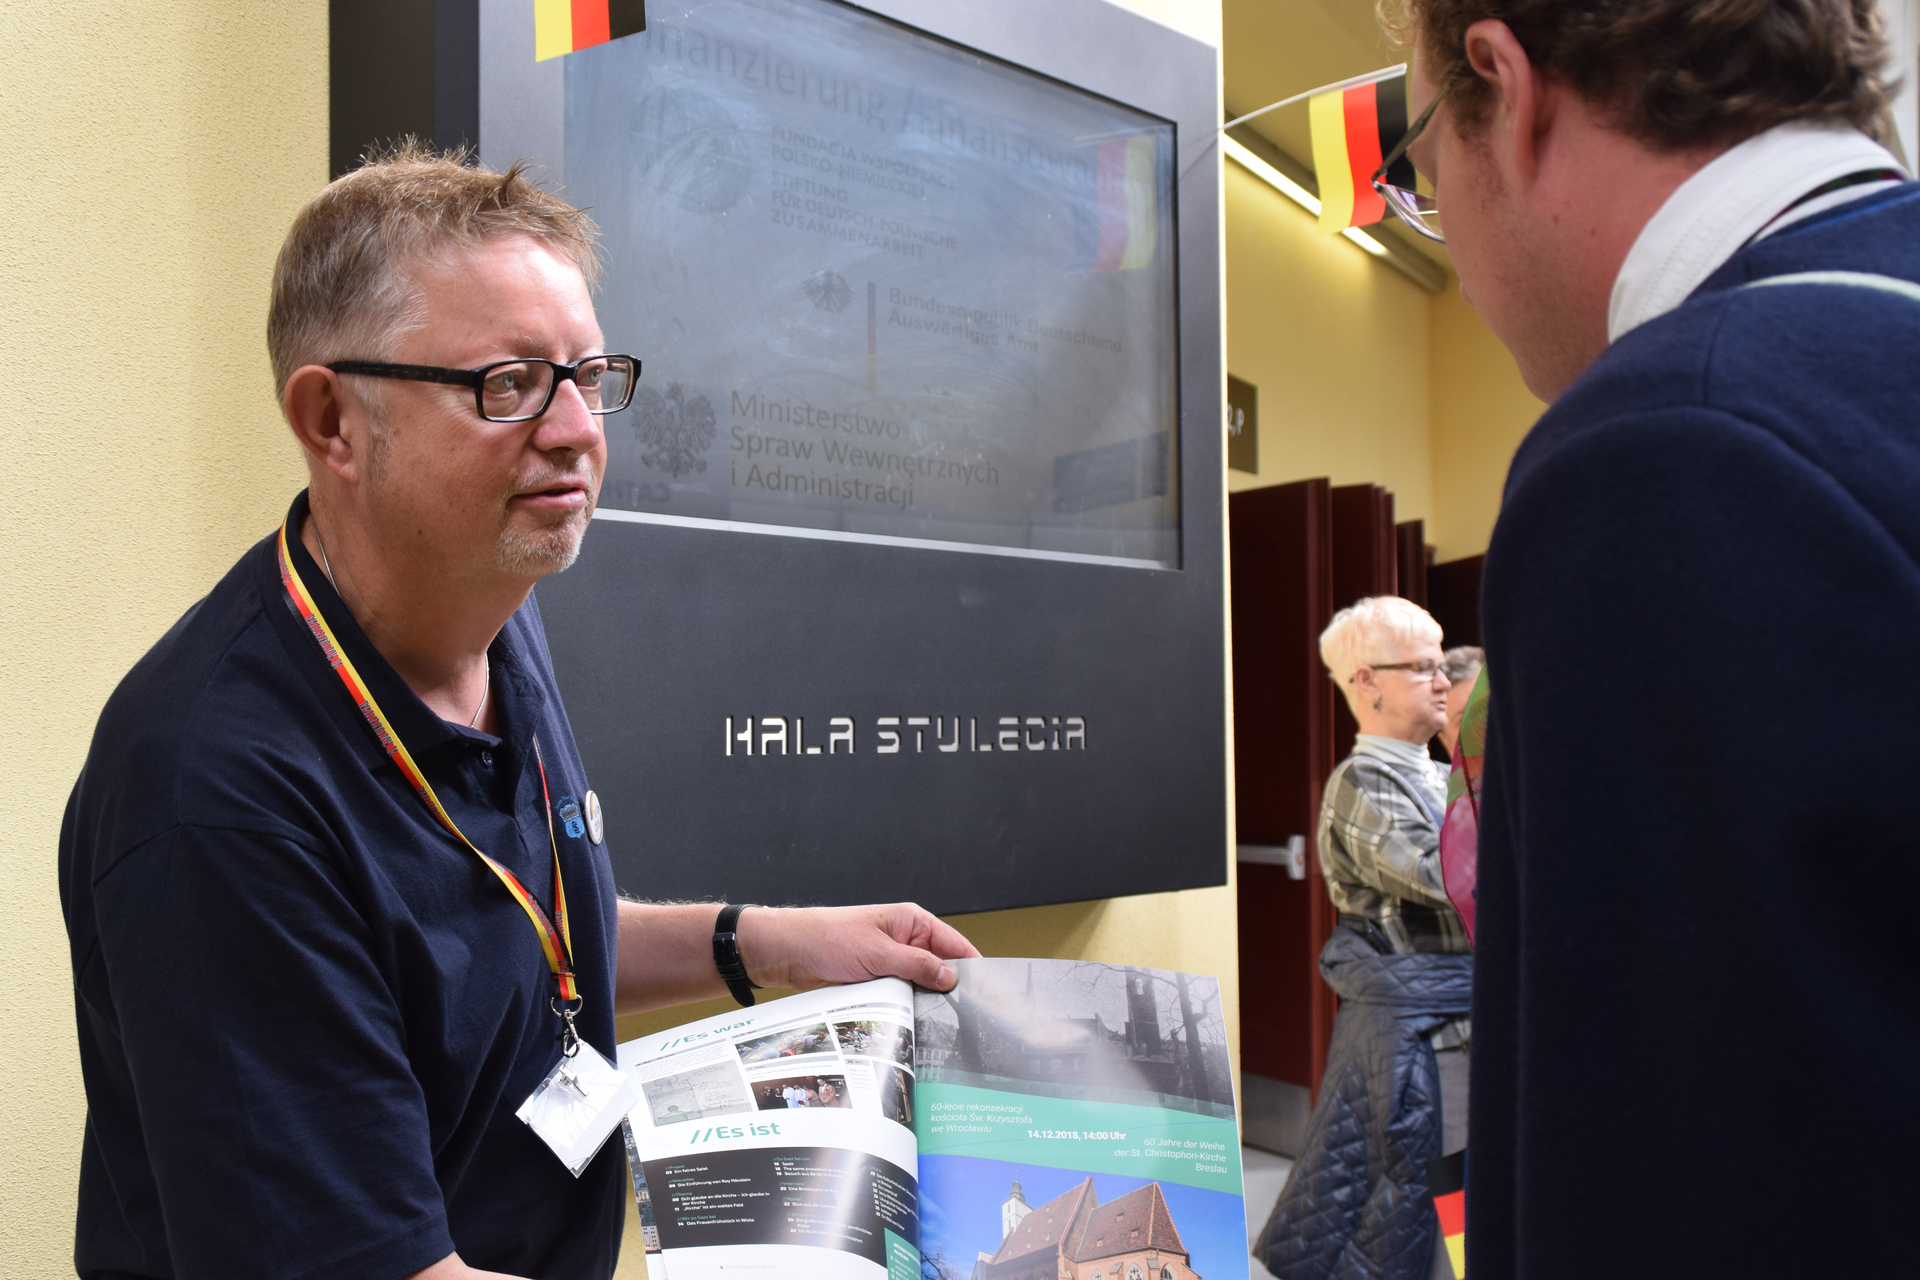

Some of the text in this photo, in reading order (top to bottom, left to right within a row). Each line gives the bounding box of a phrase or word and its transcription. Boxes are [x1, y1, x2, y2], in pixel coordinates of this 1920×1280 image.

[643, 12, 887, 131] inanzierung
[771, 125, 857, 161] FUNDACJA
[771, 171, 849, 203] STIFTUNG
[771, 189, 958, 250] FÜR DEUTSCH-POLNISCHE
[771, 209, 925, 259] ZUSAMMENARBEIT
[888, 309, 1039, 354] Auswärtiges Amt
[889, 287, 1122, 353] Bundesrepublik Deutschland
[730, 390, 901, 439] Ministerstwo
[730, 426, 1000, 487] Spraw Wewnętrznych
[731, 461, 914, 511] i Administracji
[725, 715, 855, 756] HALA
[713, 1018, 755, 1034] war
[930, 1112, 1033, 1124] kościoła Św. Krzysztofa
[931, 1102, 1024, 1114] 60-lecie rekonsekracji
[749, 1122, 781, 1136] ist
[946, 1124, 992, 1133] Wrocławiu
[1027, 1130, 1126, 1141] 14.12.2018, 14:00 Uhr
[1157, 1138, 1181, 1148] Jahre
[1184, 1140, 1197, 1148] der
[1199, 1141, 1225, 1151] Weihe
[1145, 1149, 1226, 1162] Christophori-Kirche
[1196, 1163, 1227, 1173] Breslau
